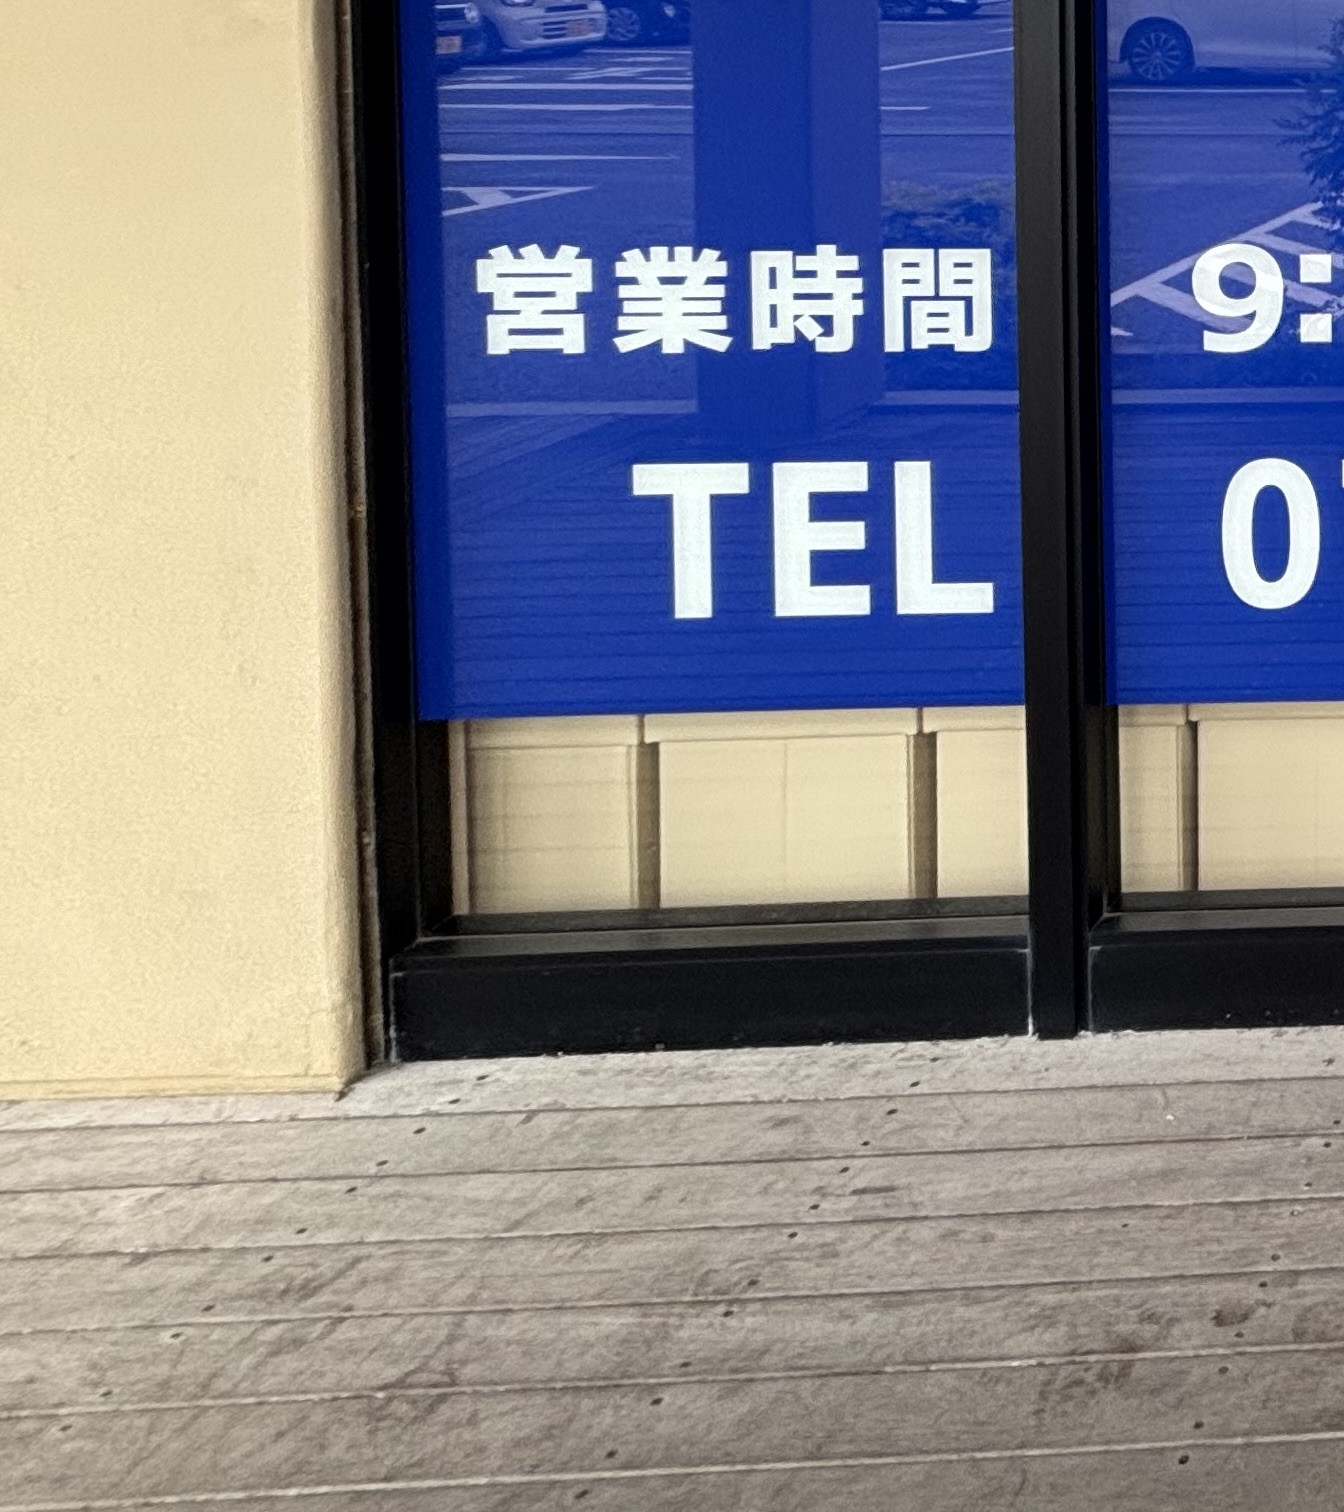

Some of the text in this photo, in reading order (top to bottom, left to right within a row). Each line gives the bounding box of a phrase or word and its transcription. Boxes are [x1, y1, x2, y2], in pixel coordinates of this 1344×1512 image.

[476, 244, 993, 355] 営業時間
[632, 461, 994, 619] TEL
